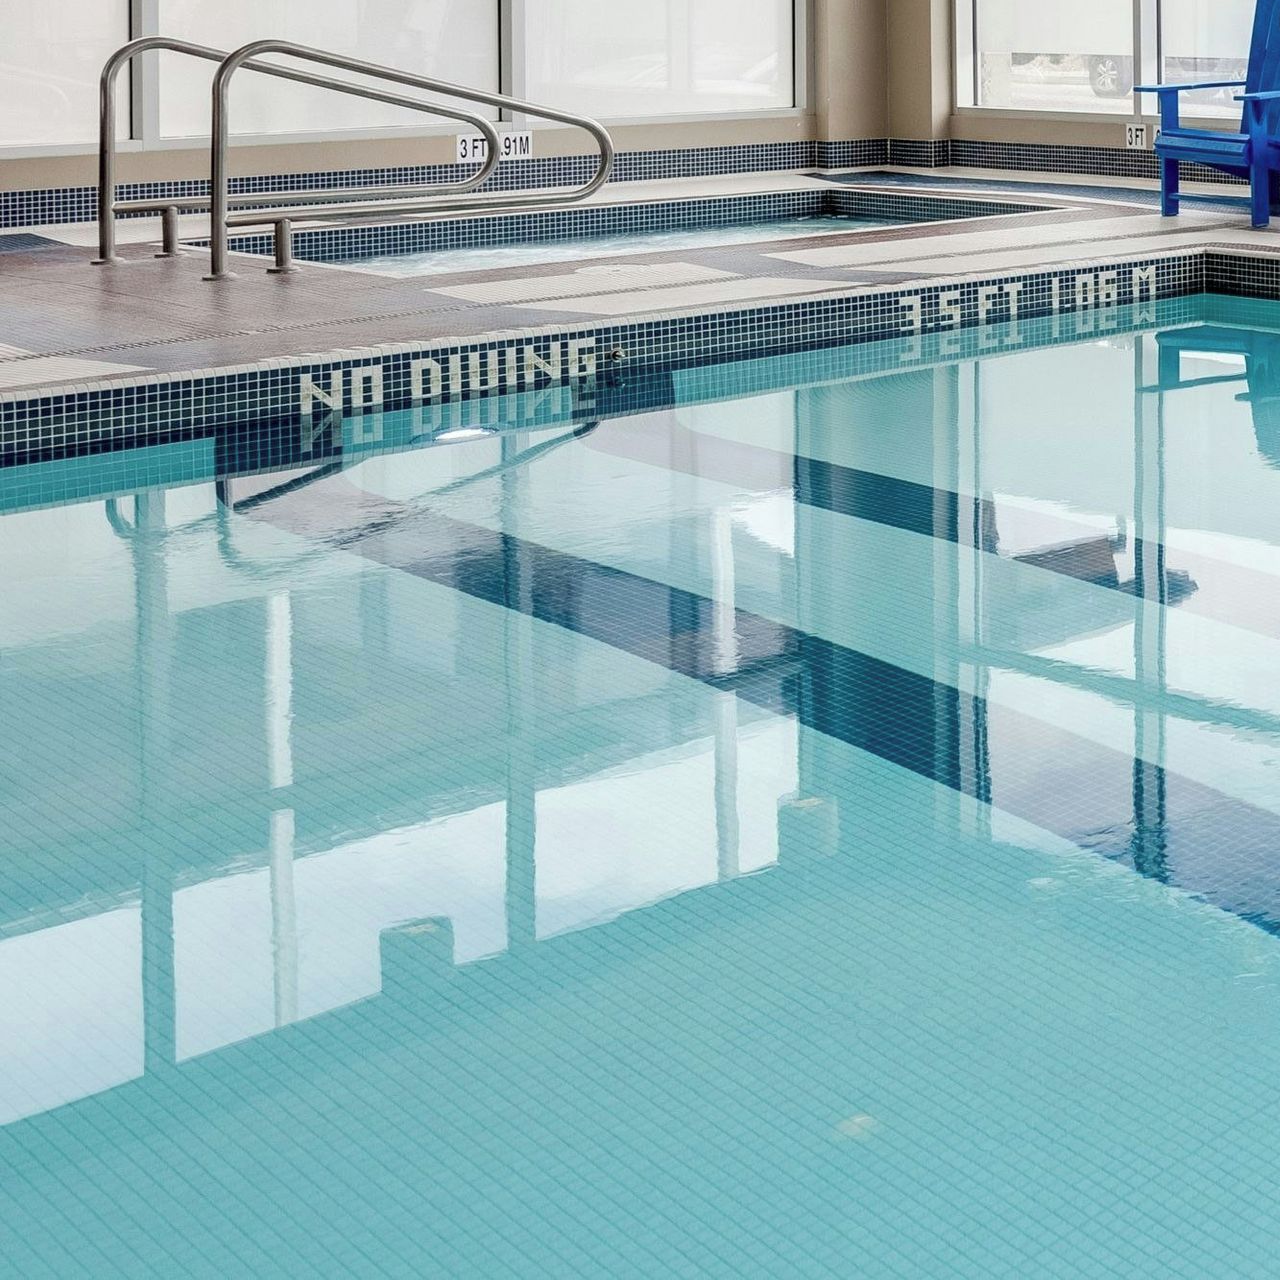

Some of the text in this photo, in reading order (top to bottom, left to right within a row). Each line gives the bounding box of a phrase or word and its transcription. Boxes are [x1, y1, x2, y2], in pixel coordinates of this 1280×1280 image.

[460, 136, 529, 158] 3 FT .91M
[1128, 127, 1133, 146] 3
[1135, 127, 1144, 146] FT
[979, 282, 1023, 322] FT
[1133, 266, 1156, 297] M
[300, 337, 596, 415] NO DIVING
